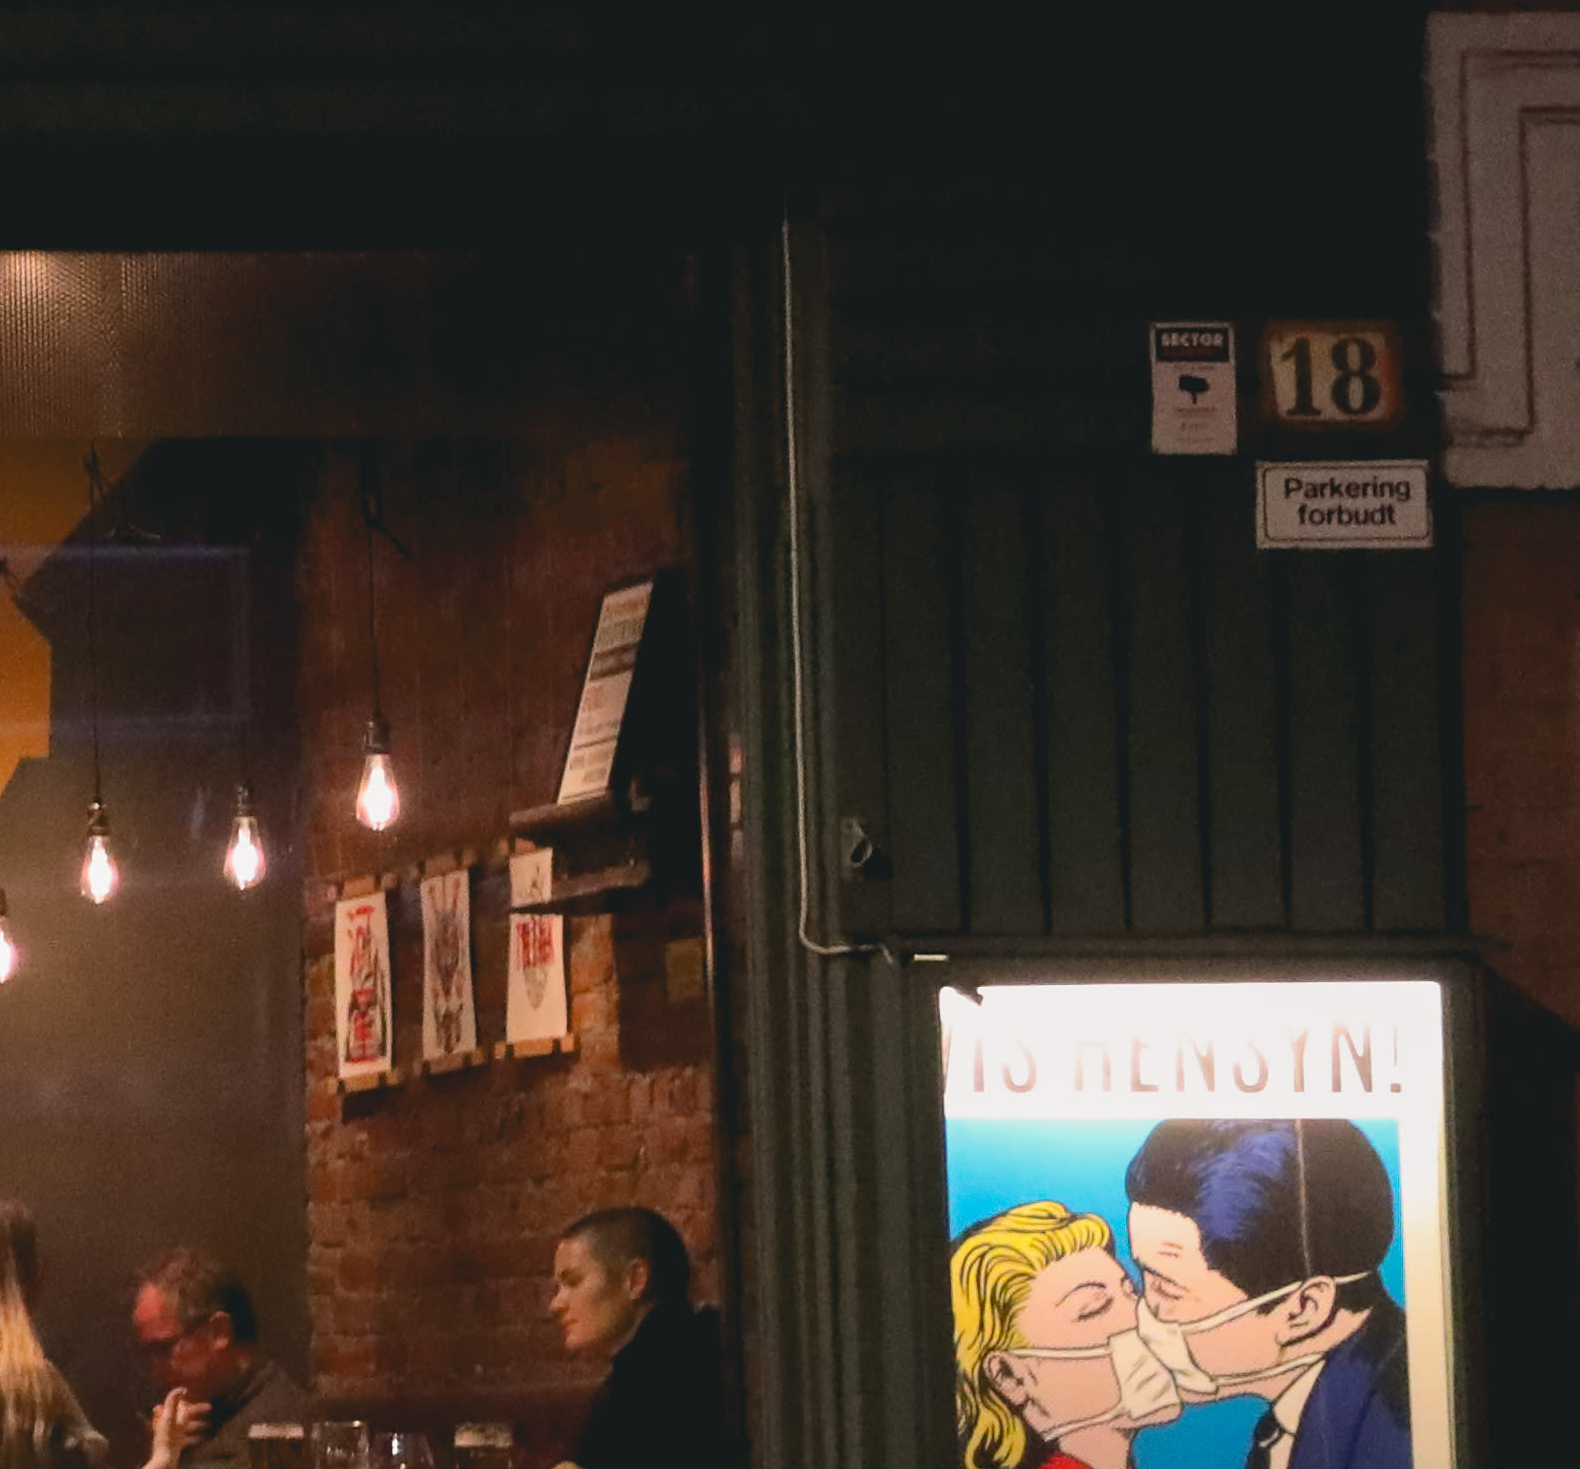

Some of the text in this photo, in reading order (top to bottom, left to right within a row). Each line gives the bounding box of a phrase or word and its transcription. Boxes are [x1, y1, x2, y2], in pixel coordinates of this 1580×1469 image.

[1280, 337, 1380, 415] 18
[1284, 477, 1410, 502] Parkering
[1298, 504, 1396, 526] forbudt
[942, 1022, 1403, 1094] IS HENSYN!
